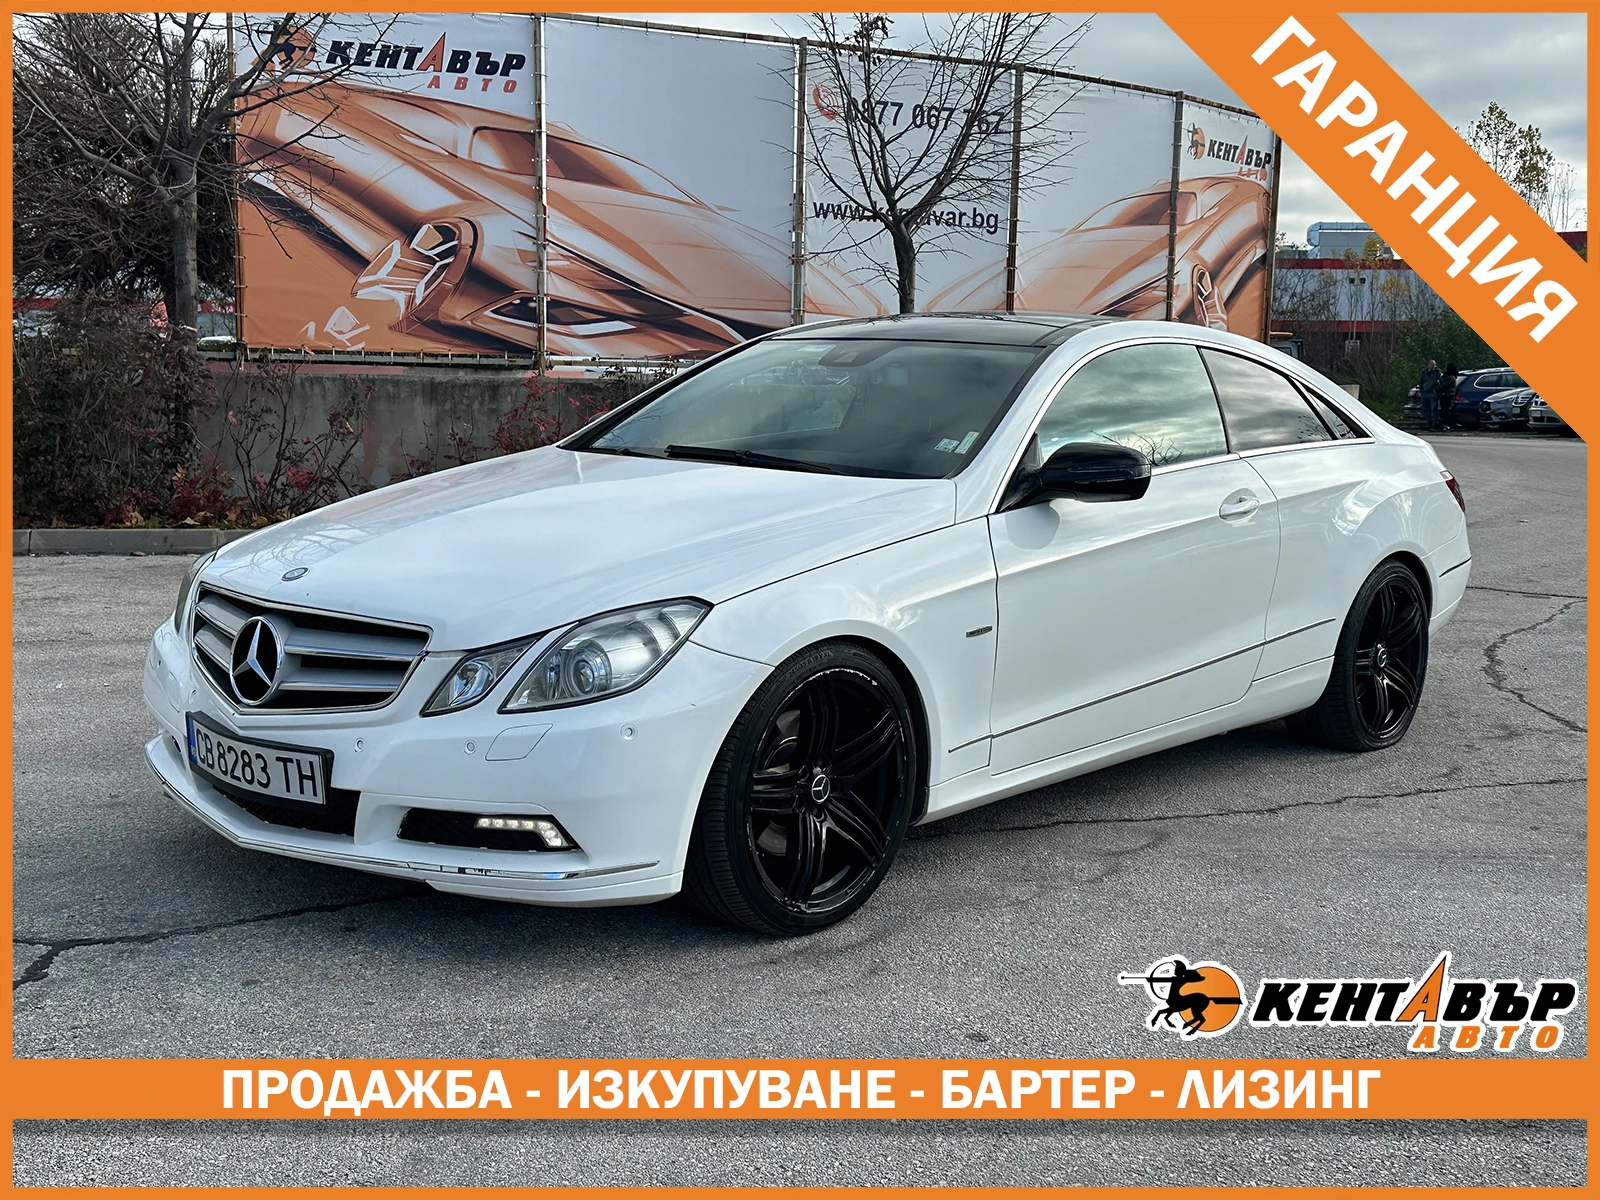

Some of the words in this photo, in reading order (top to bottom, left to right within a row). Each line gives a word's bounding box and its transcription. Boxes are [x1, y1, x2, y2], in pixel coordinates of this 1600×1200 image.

[326, 32, 526, 78] КЕНТАВЪР
[427, 75, 517, 93] АВТО
[911, 103, 953, 131] 067
[1207, 135, 1272, 169] КЕНТАВЪР
[196, 728, 214, 770] CB
[217, 741, 271, 789] 8283
[275, 756, 318, 797] TH
